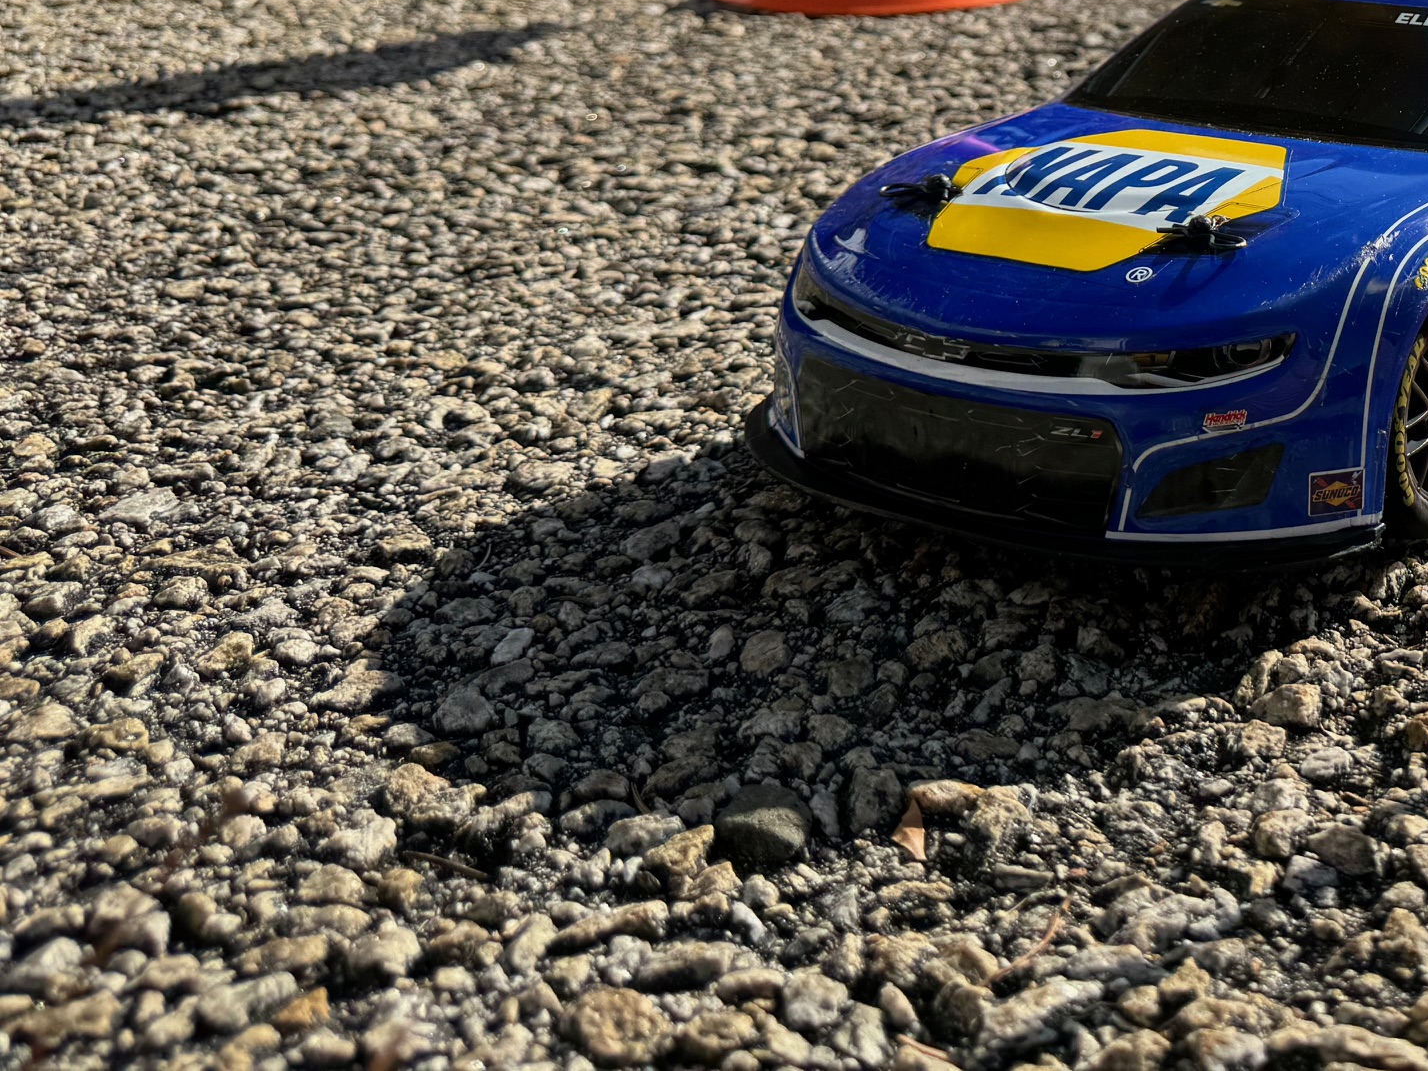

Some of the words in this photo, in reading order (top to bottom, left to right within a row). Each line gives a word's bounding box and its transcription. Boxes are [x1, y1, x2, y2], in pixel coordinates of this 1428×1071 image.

[973, 146, 1246, 223] NAPA
[1204, 409, 1247, 426] Hendrick
[1312, 485, 1361, 502] SUNOCO
